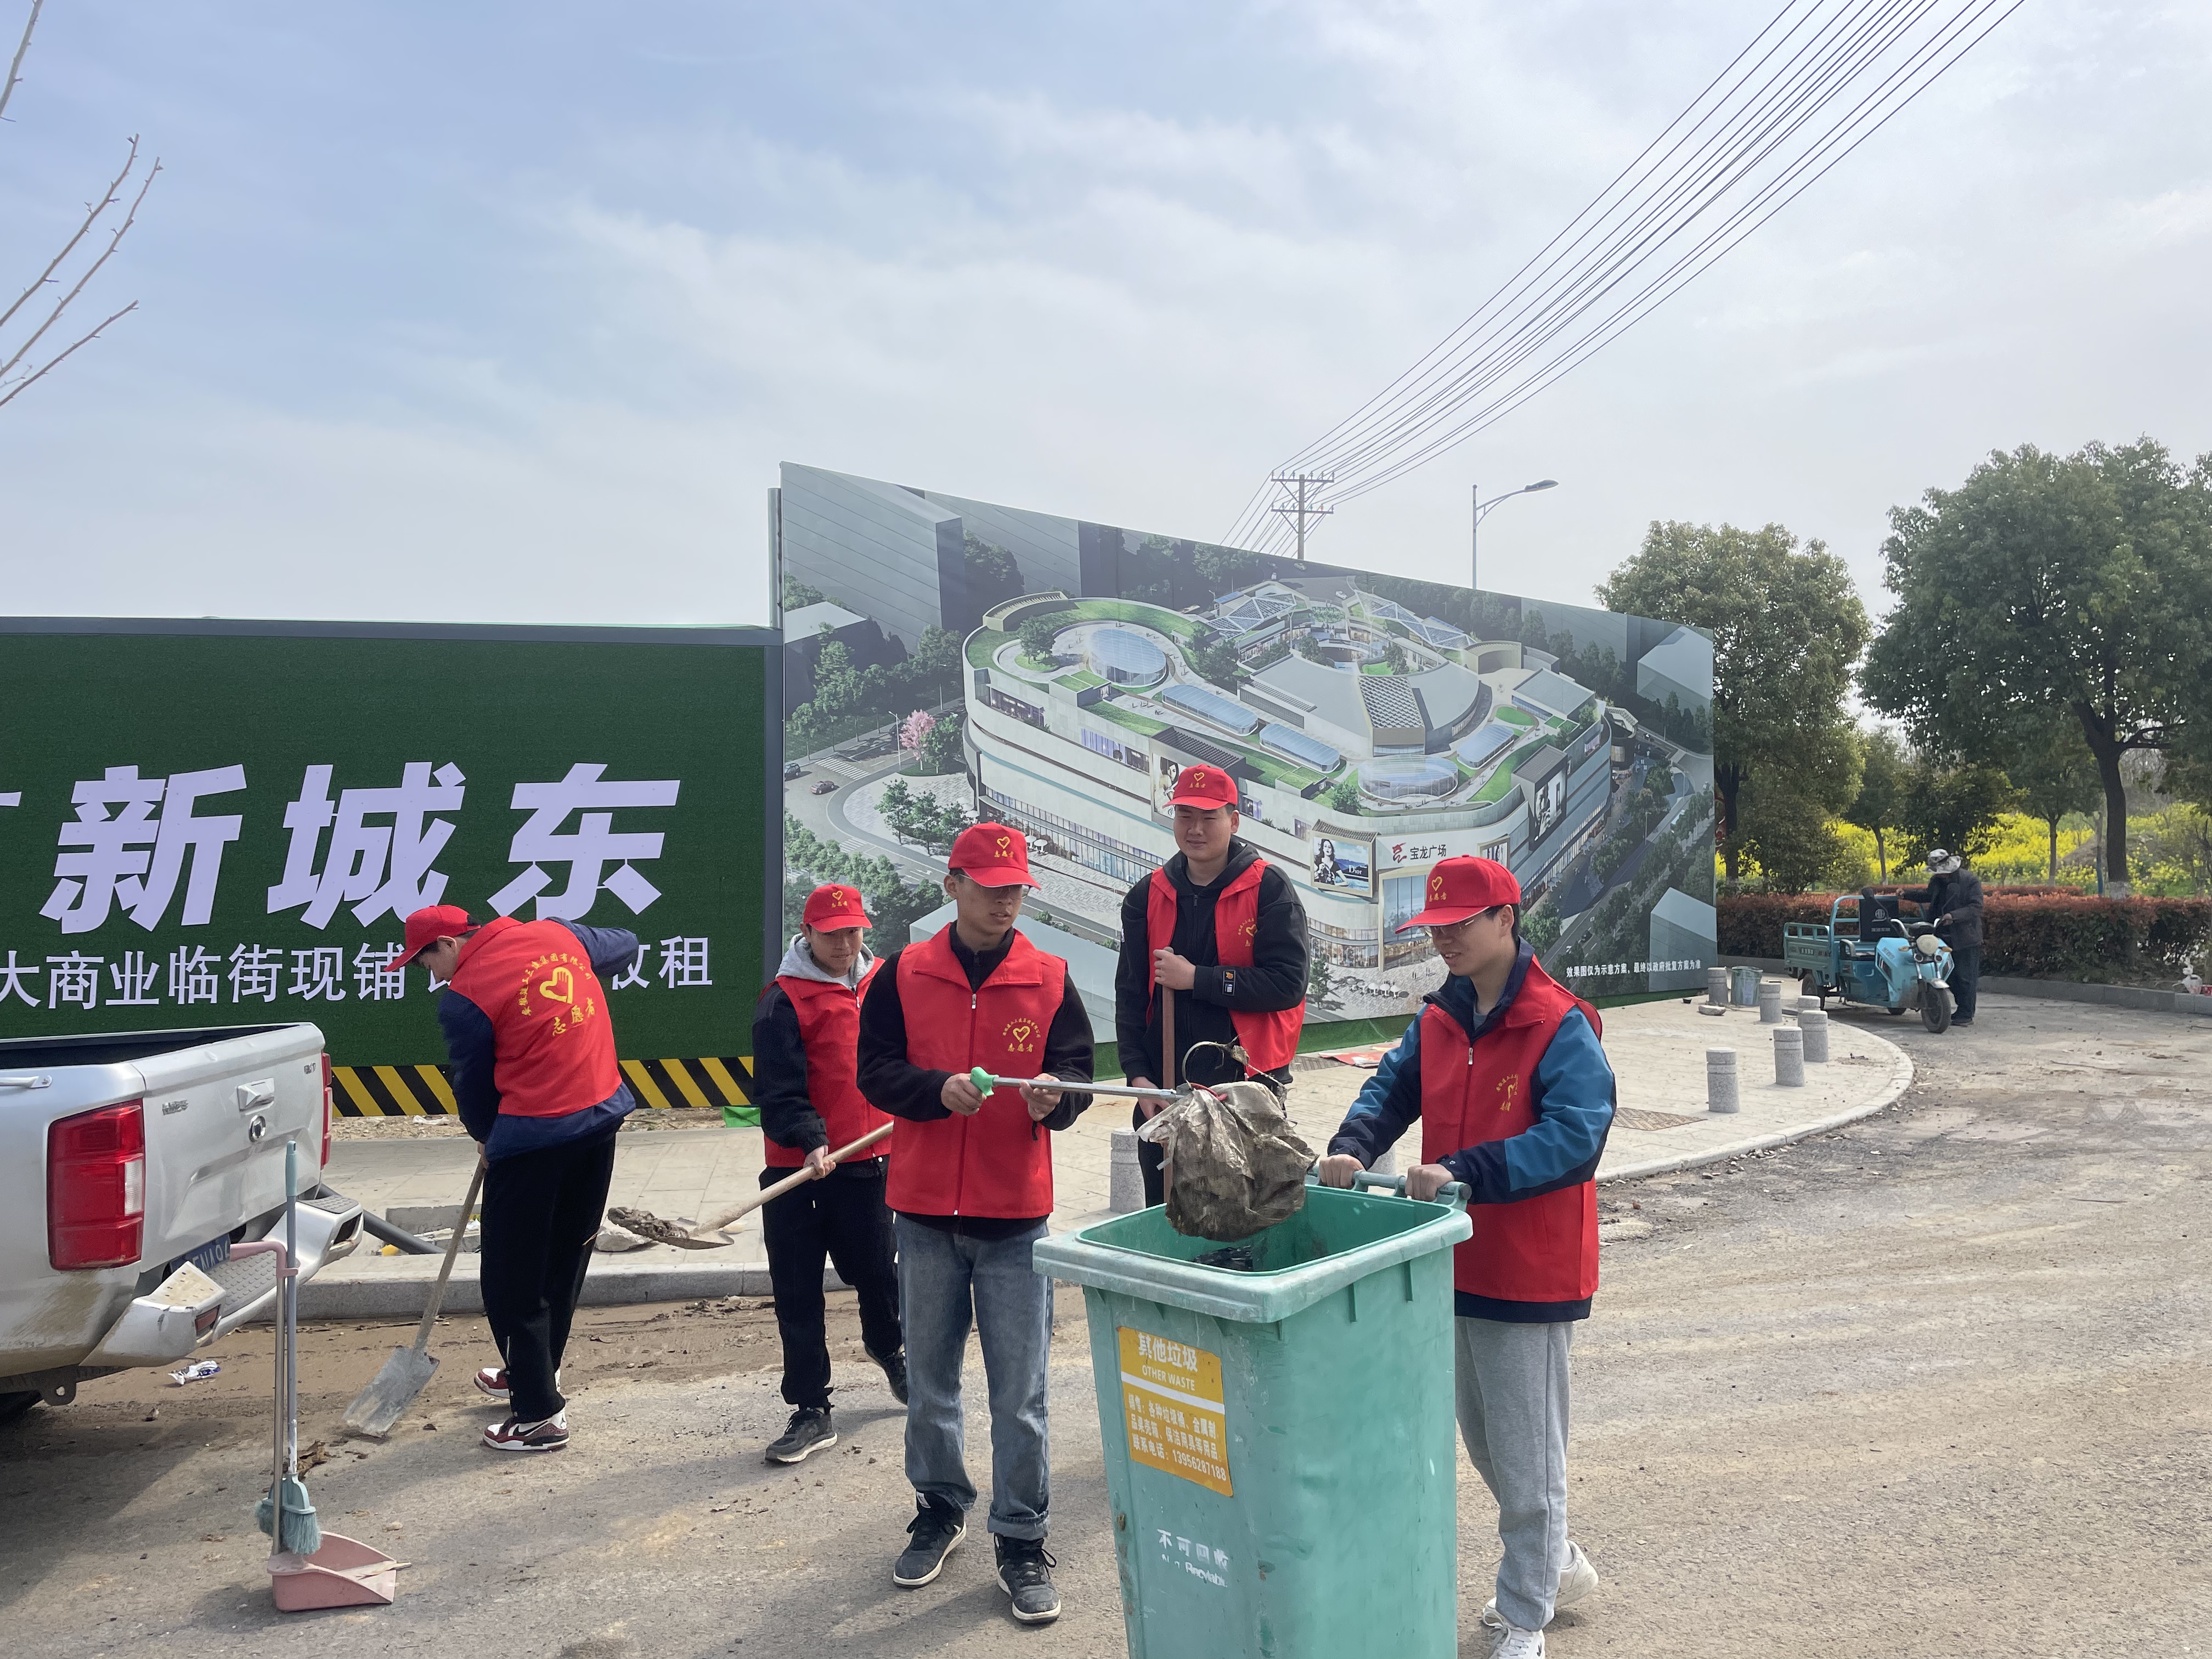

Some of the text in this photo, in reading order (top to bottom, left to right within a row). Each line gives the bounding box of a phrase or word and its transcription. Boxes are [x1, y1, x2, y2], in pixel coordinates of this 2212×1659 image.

[0, 761, 681, 934] 新城东
[1410, 844, 1447, 860] 宝龙广场
[1348, 864, 1362, 875] Dior
[552, 997, 595, 1037] 志愿者
[1138, 1332, 1198, 1373] 其他垃圾
[1142, 1364, 1195, 1391] OTHER WASTE
[1156, 1528, 1229, 1572] 不可回收
